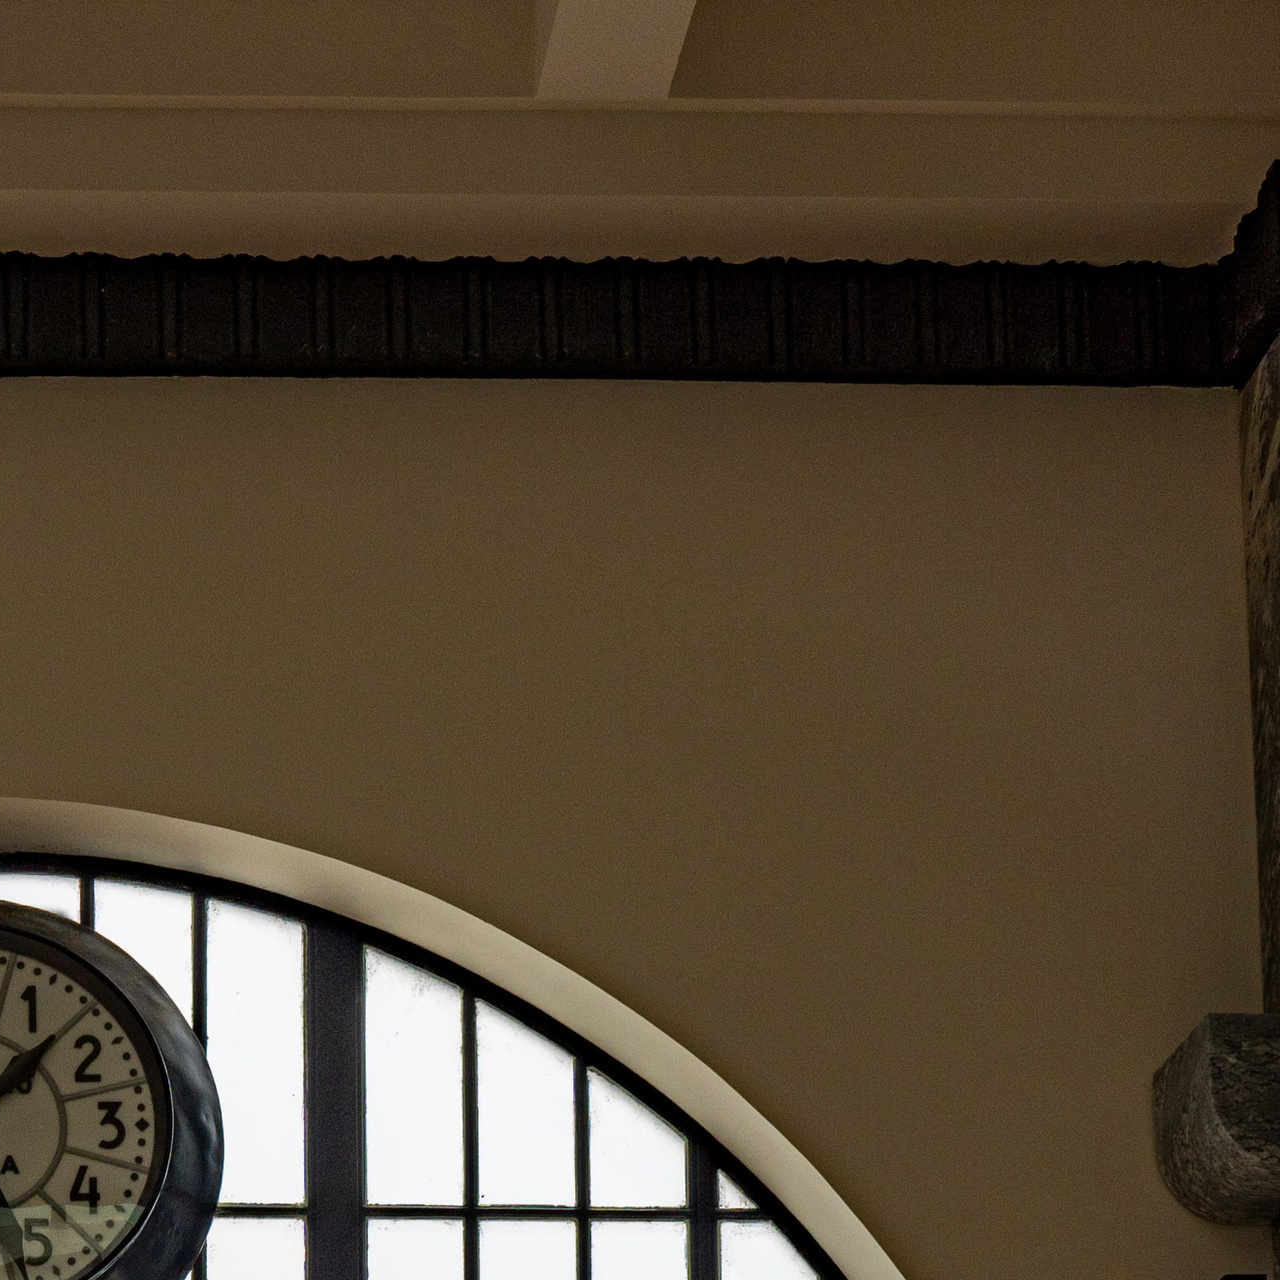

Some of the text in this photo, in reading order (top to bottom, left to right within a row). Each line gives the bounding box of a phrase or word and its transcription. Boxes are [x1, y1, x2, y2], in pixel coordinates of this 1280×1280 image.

[20, 984, 38, 1034] 1
[73, 1034, 102, 1084] 2
[97, 1100, 126, 1150] 3
[68, 1164, 101, 1214] 4
[23, 1217, 53, 1267] 5
